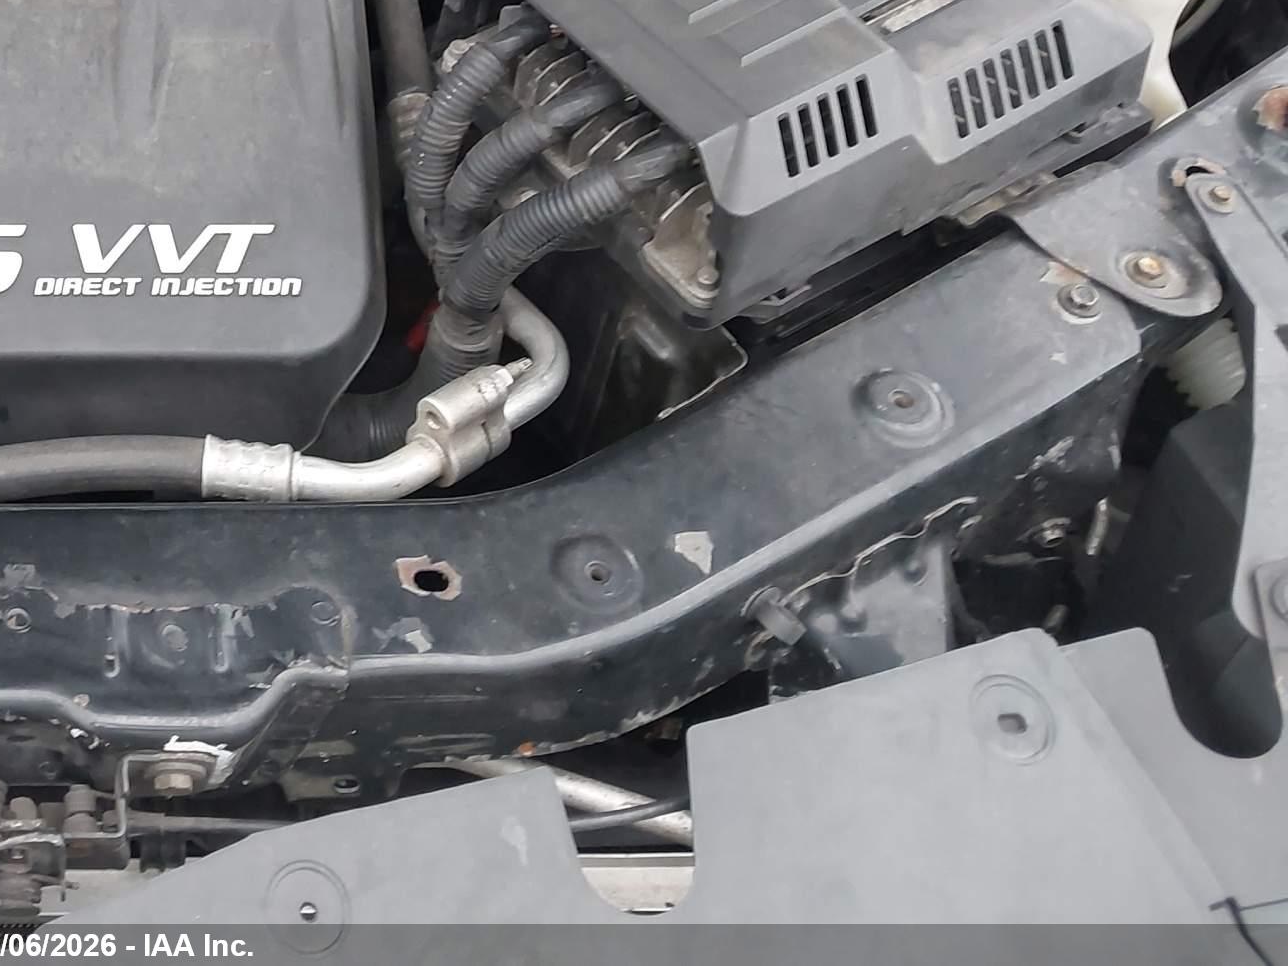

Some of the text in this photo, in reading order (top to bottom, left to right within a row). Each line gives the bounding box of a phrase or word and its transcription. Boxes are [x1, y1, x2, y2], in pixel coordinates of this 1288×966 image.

[71, 222, 276, 275] VVT
[33, 276, 303, 297] DIRECT INJECTION
